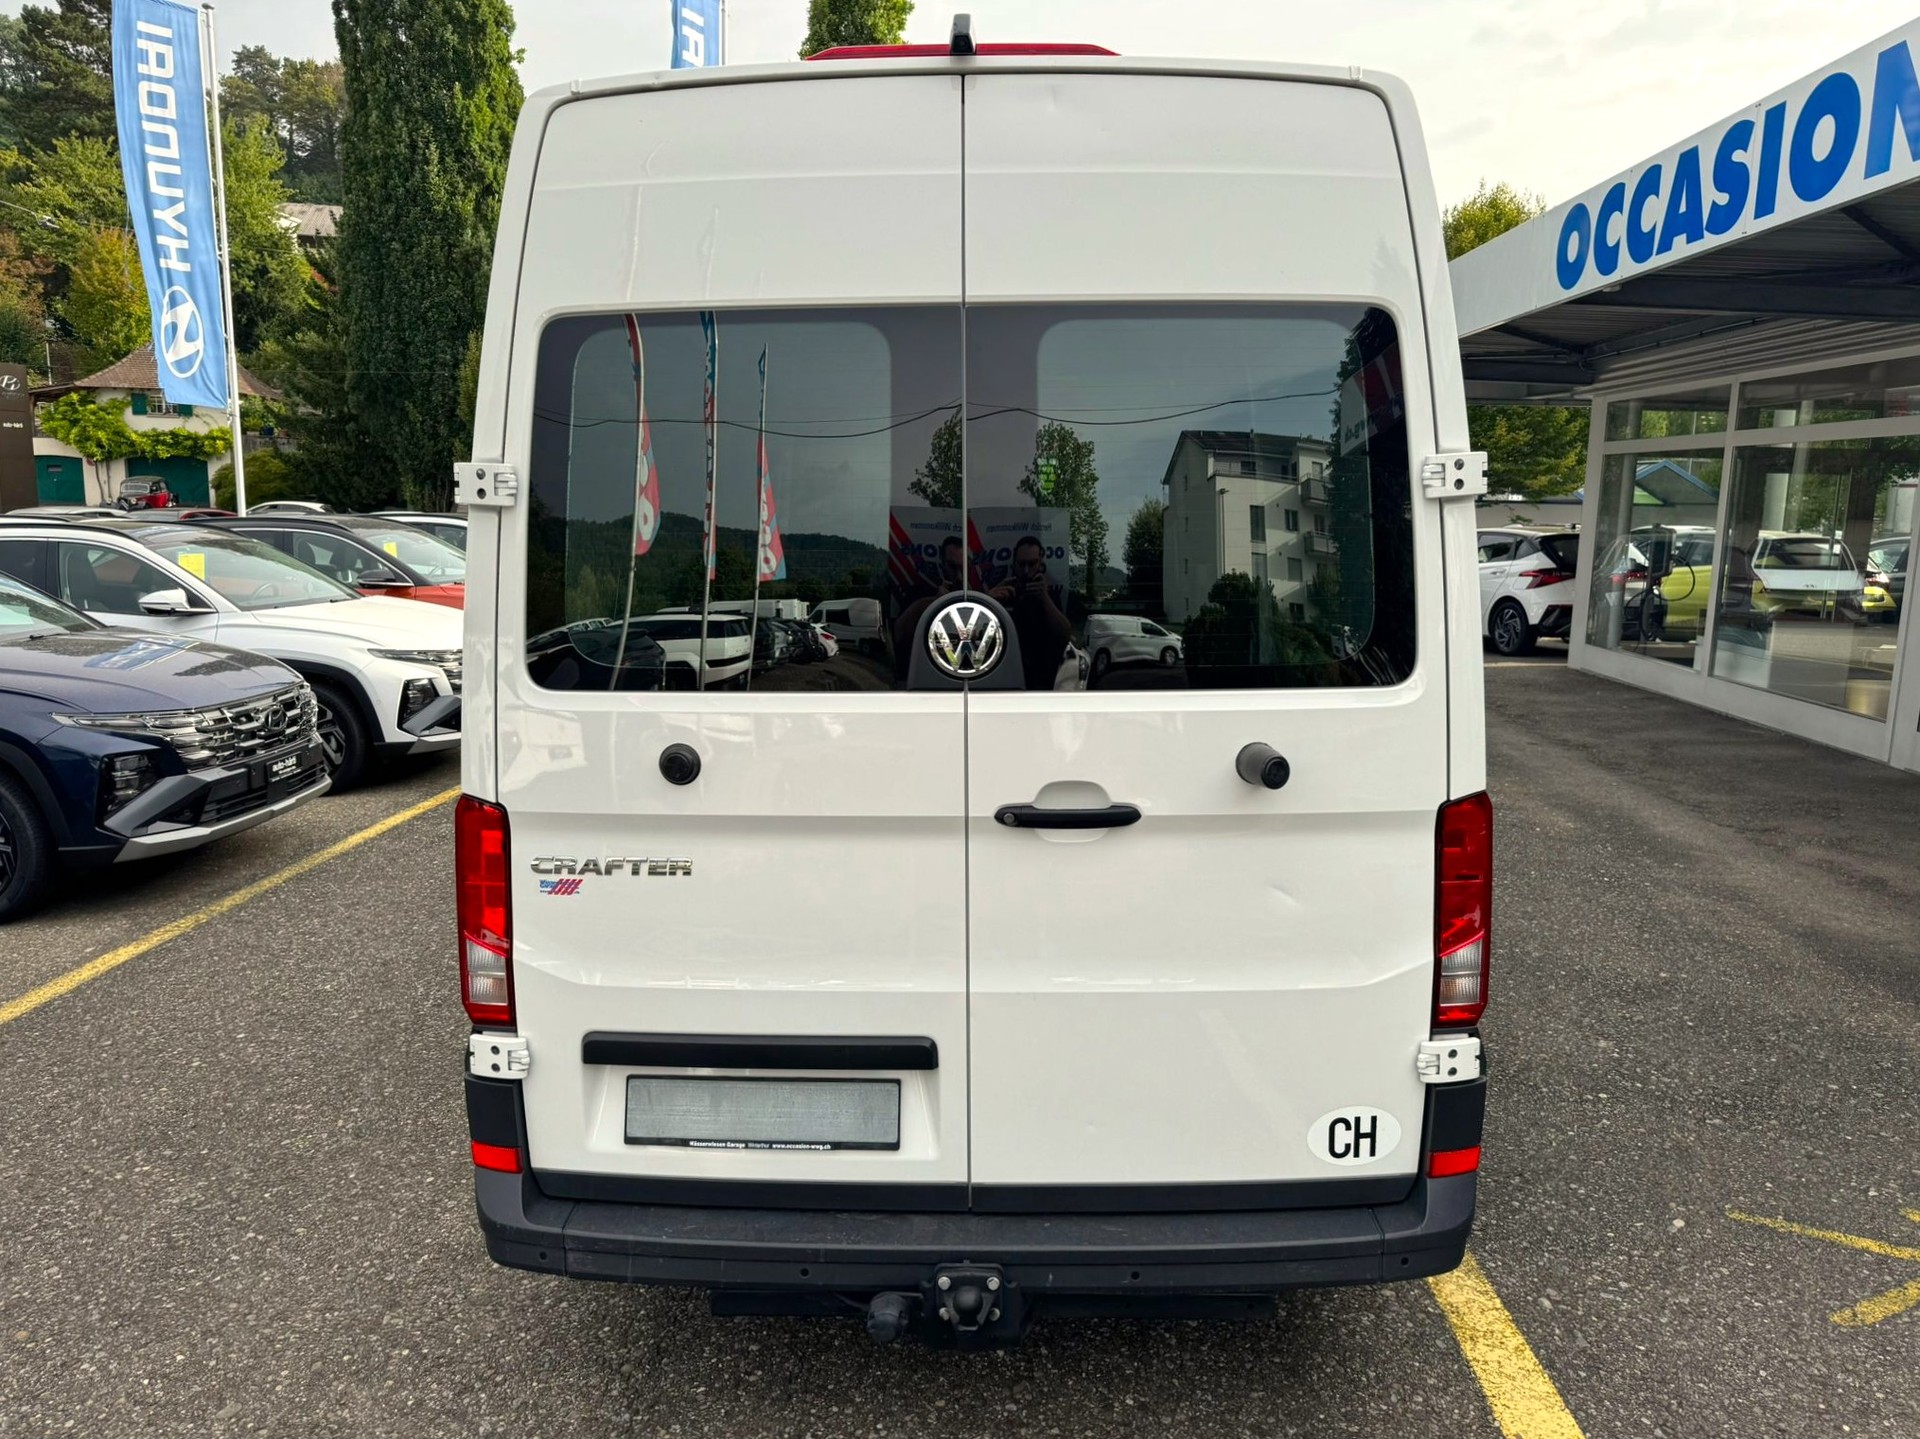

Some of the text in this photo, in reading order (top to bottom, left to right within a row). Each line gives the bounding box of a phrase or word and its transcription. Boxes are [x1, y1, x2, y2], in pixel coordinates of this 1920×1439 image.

[530, 855, 693, 876] CRAFTER
[726, 1141, 746, 1150] Garage
[1328, 1115, 1377, 1159] CH
